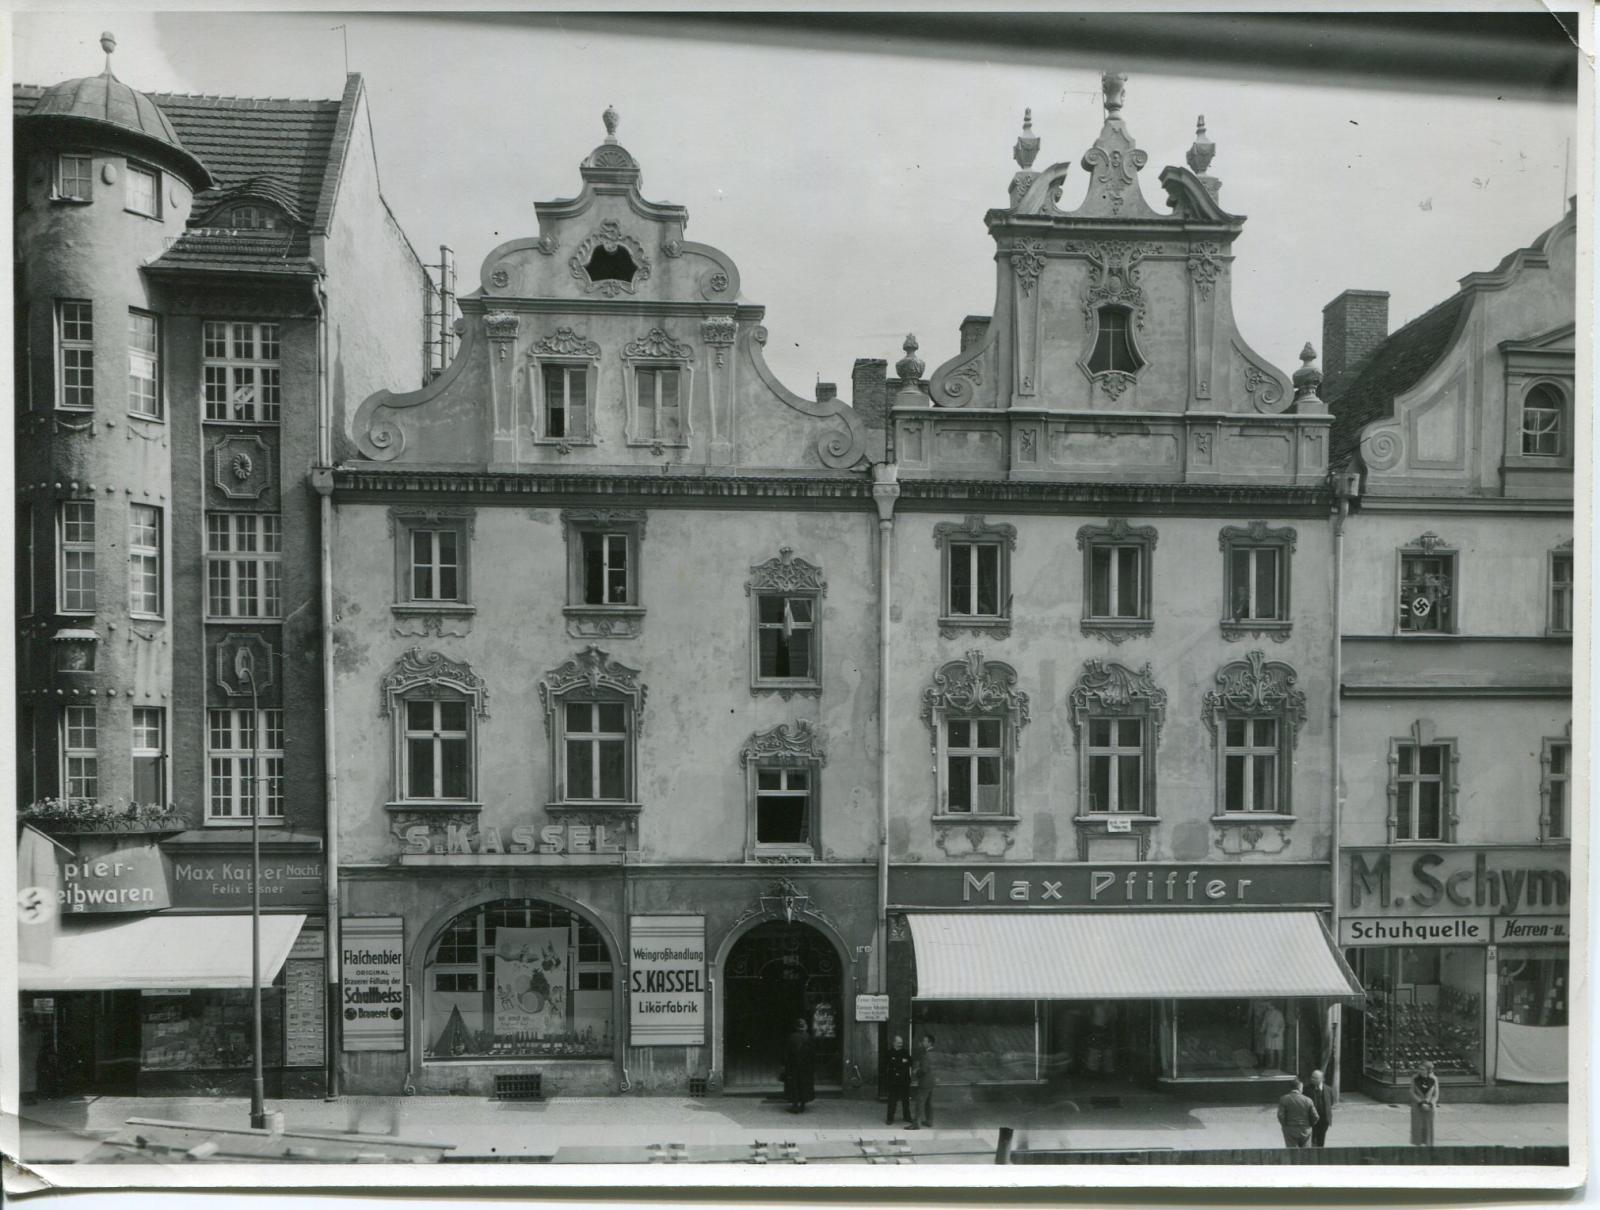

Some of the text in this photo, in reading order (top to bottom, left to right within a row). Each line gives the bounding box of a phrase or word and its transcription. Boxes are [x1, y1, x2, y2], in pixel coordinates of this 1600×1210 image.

[175, 863, 322, 881] Max Kaier Nachf.
[212, 882, 284, 895] Felix Esner
[963, 871, 1252, 900] Max Pfiffer
[1411, 853, 1569, 916] Schym
[1351, 919, 1480, 940] Schuhquelle
[632, 969, 704, 993] S.KASSEL
[639, 1000, 698, 1014] Likörfabrik
